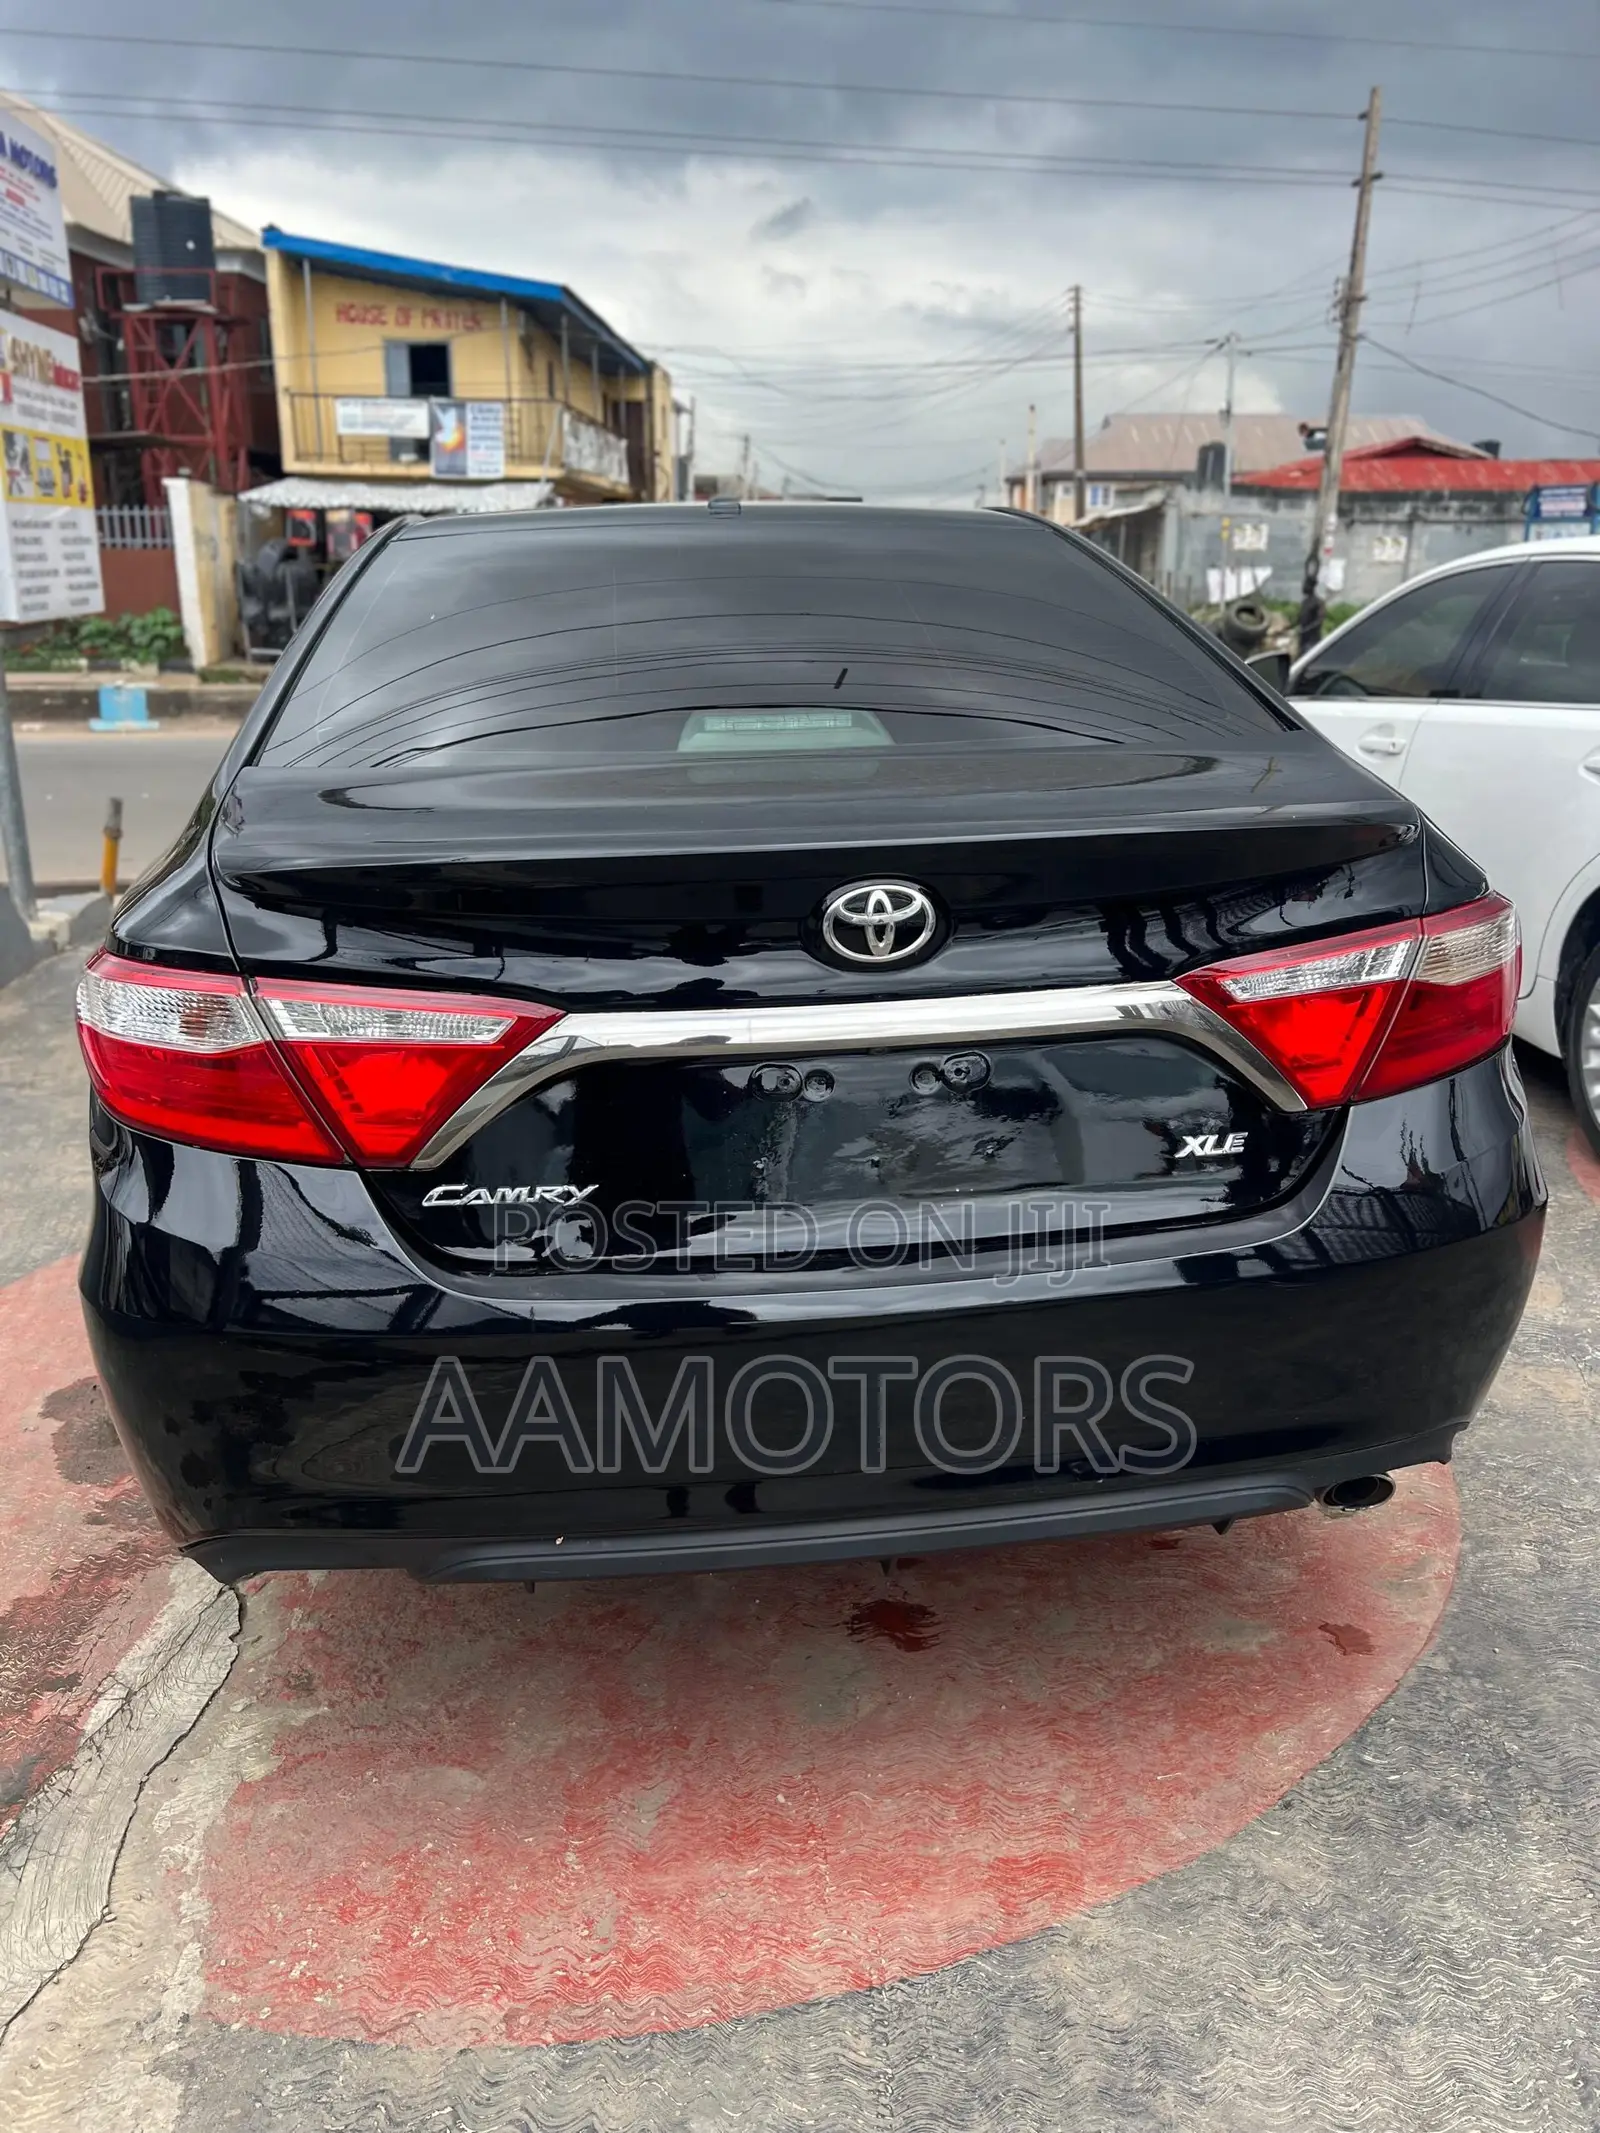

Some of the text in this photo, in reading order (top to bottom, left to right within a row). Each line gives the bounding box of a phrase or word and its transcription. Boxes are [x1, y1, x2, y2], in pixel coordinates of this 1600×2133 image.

[336, 301, 388, 326] HOUSE
[1174, 1132, 1249, 1158] XLE
[422, 1183, 599, 1207] CAMRY
